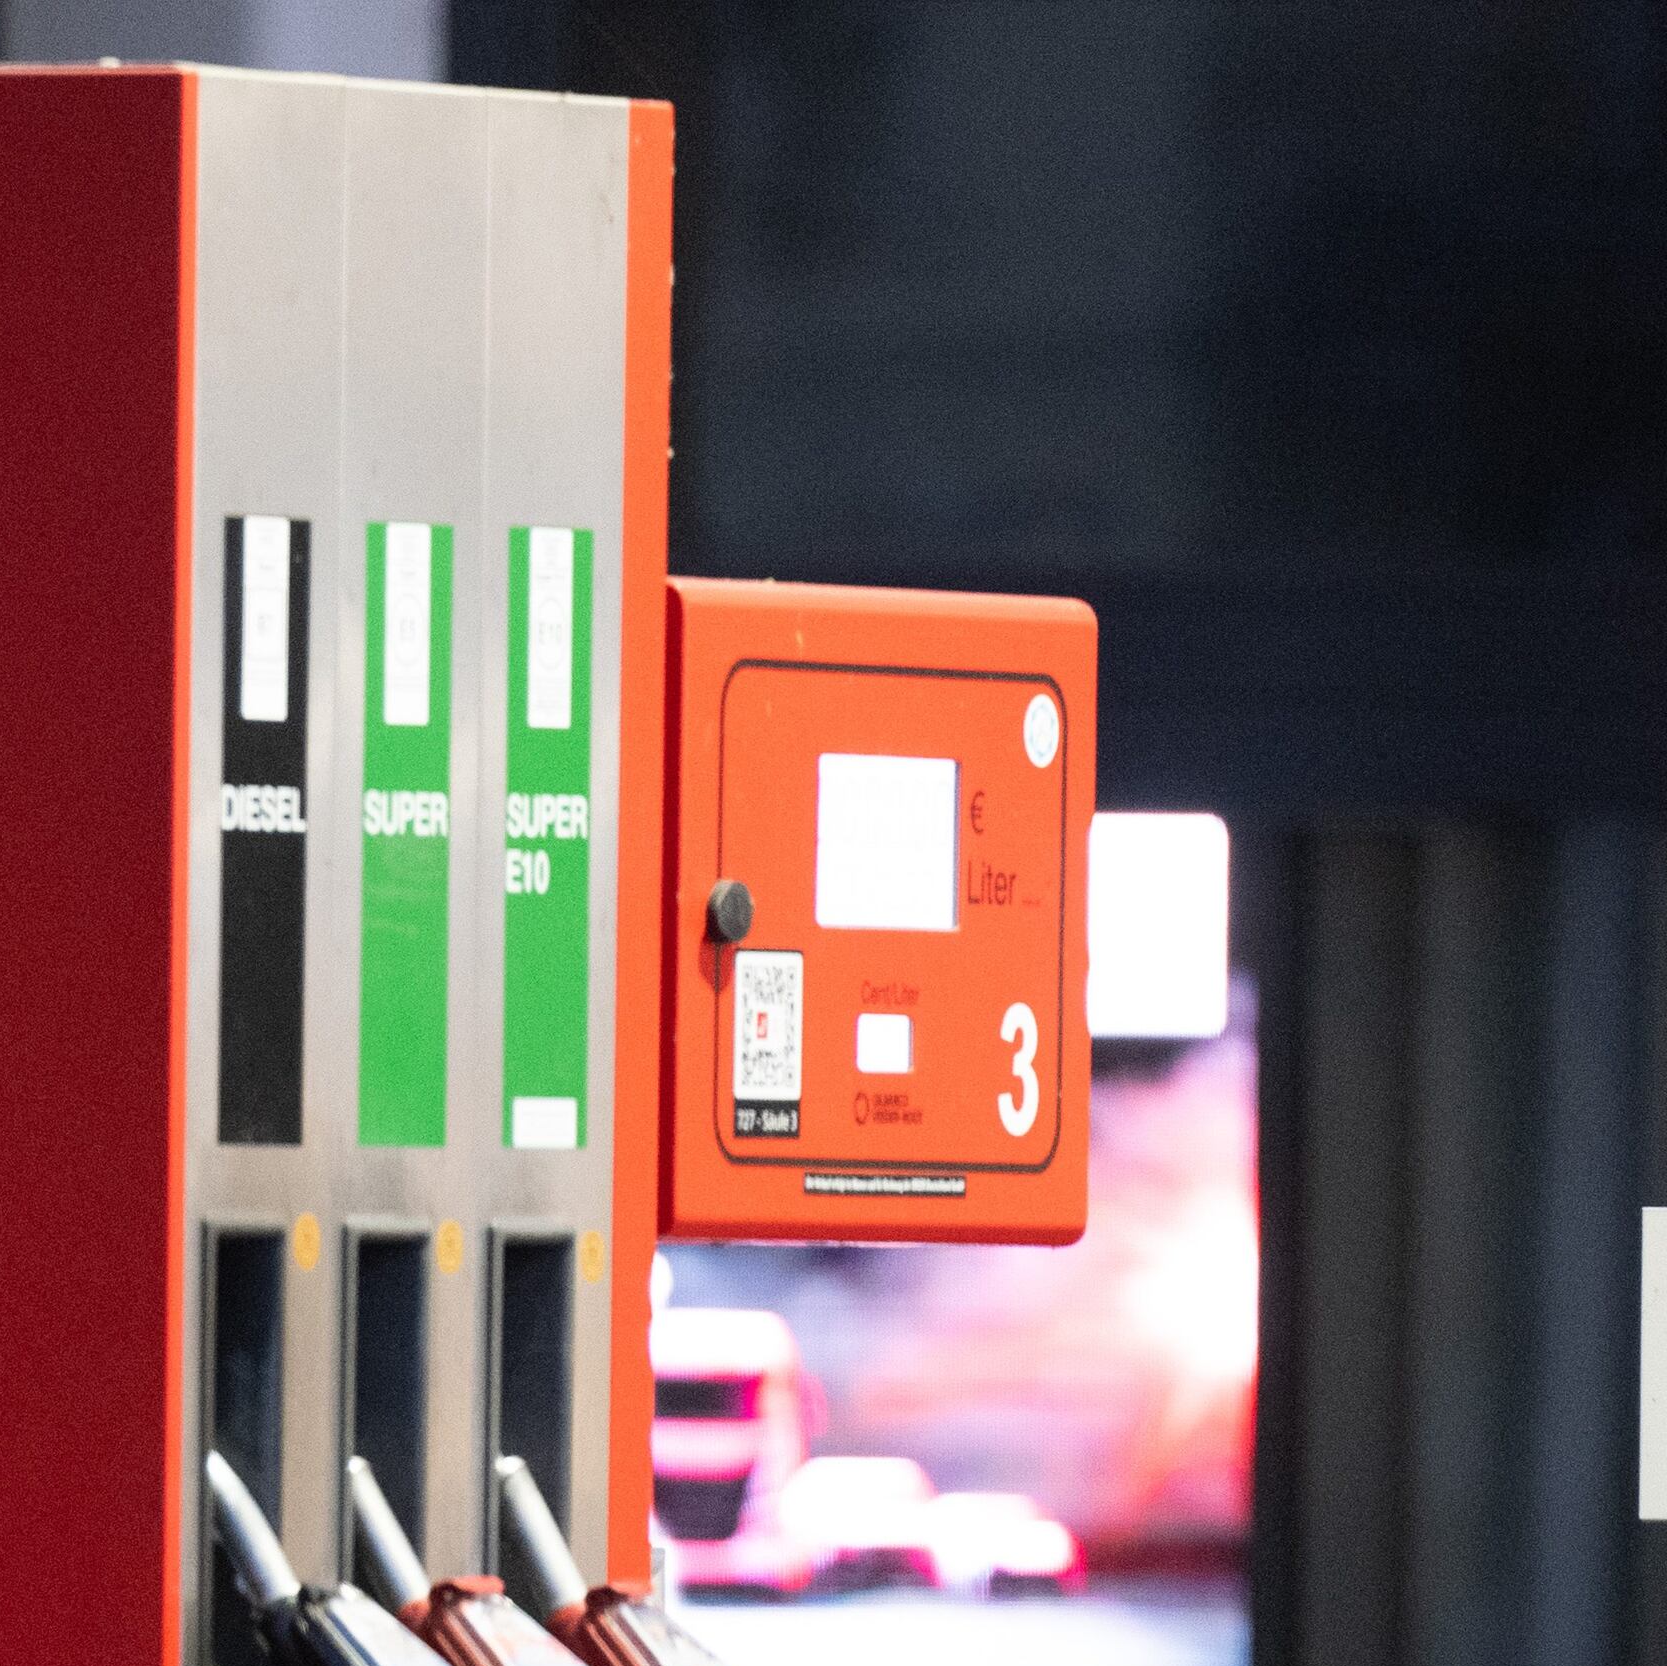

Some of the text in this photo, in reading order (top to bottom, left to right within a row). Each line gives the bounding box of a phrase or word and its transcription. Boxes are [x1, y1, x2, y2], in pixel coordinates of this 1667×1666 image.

[220, 784, 307, 833] DIESEL
[364, 788, 449, 837] SUPER
[506, 792, 589, 839] SUPER
[505, 849, 550, 894] E10
[967, 859, 1017, 906] Liter
[997, 1002, 1040, 1137] 3
